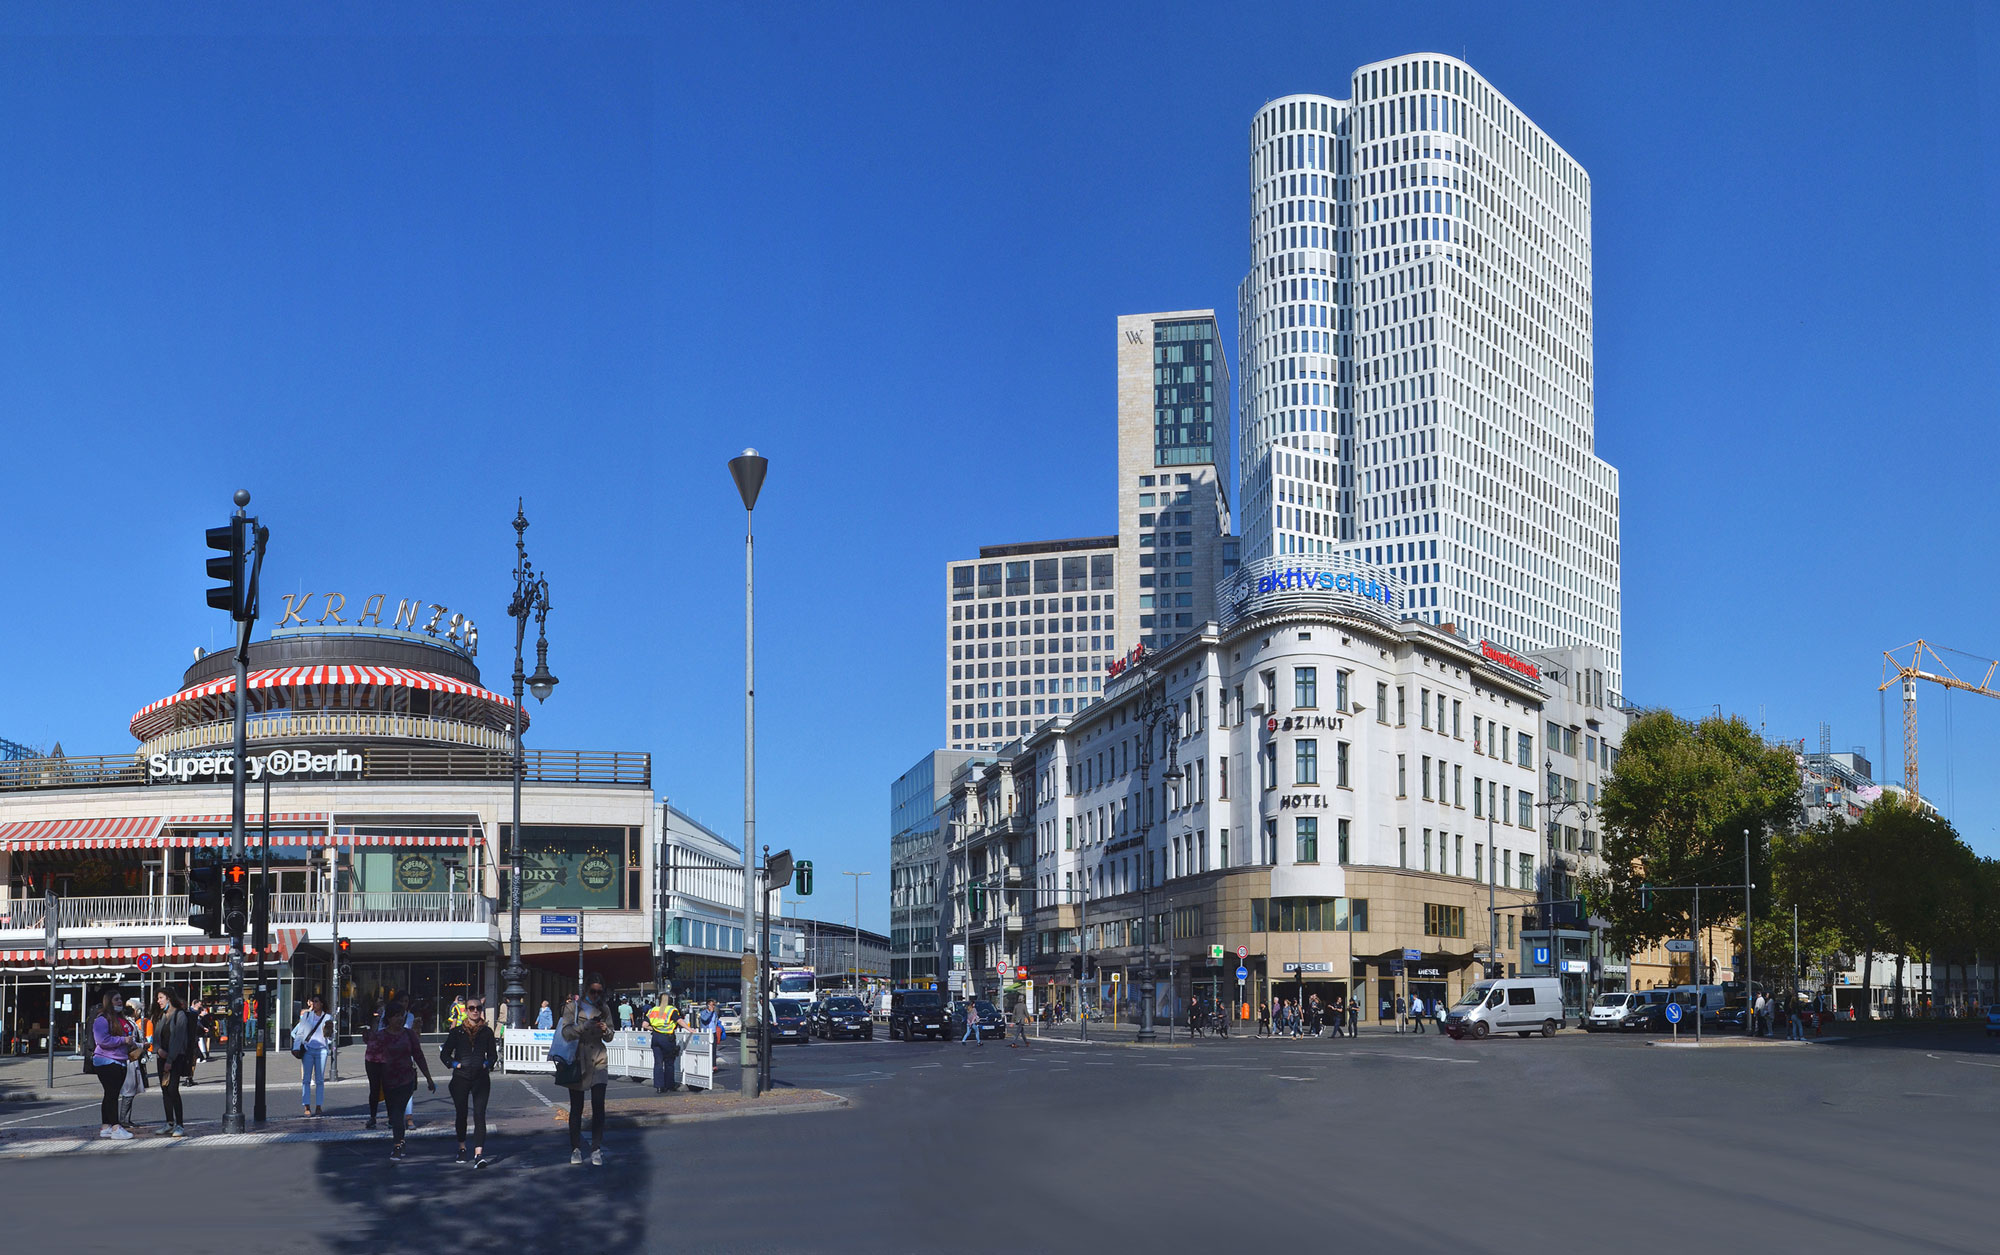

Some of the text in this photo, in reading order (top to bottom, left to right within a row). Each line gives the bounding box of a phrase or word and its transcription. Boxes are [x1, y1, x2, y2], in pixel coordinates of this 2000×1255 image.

[1258, 567, 1383, 602] aktivschuh
[1280, 794, 1328, 811] HOTEL
[1537, 948, 1548, 963] U
[1417, 968, 1440, 976] DIESEL
[1561, 961, 1567, 972] U
